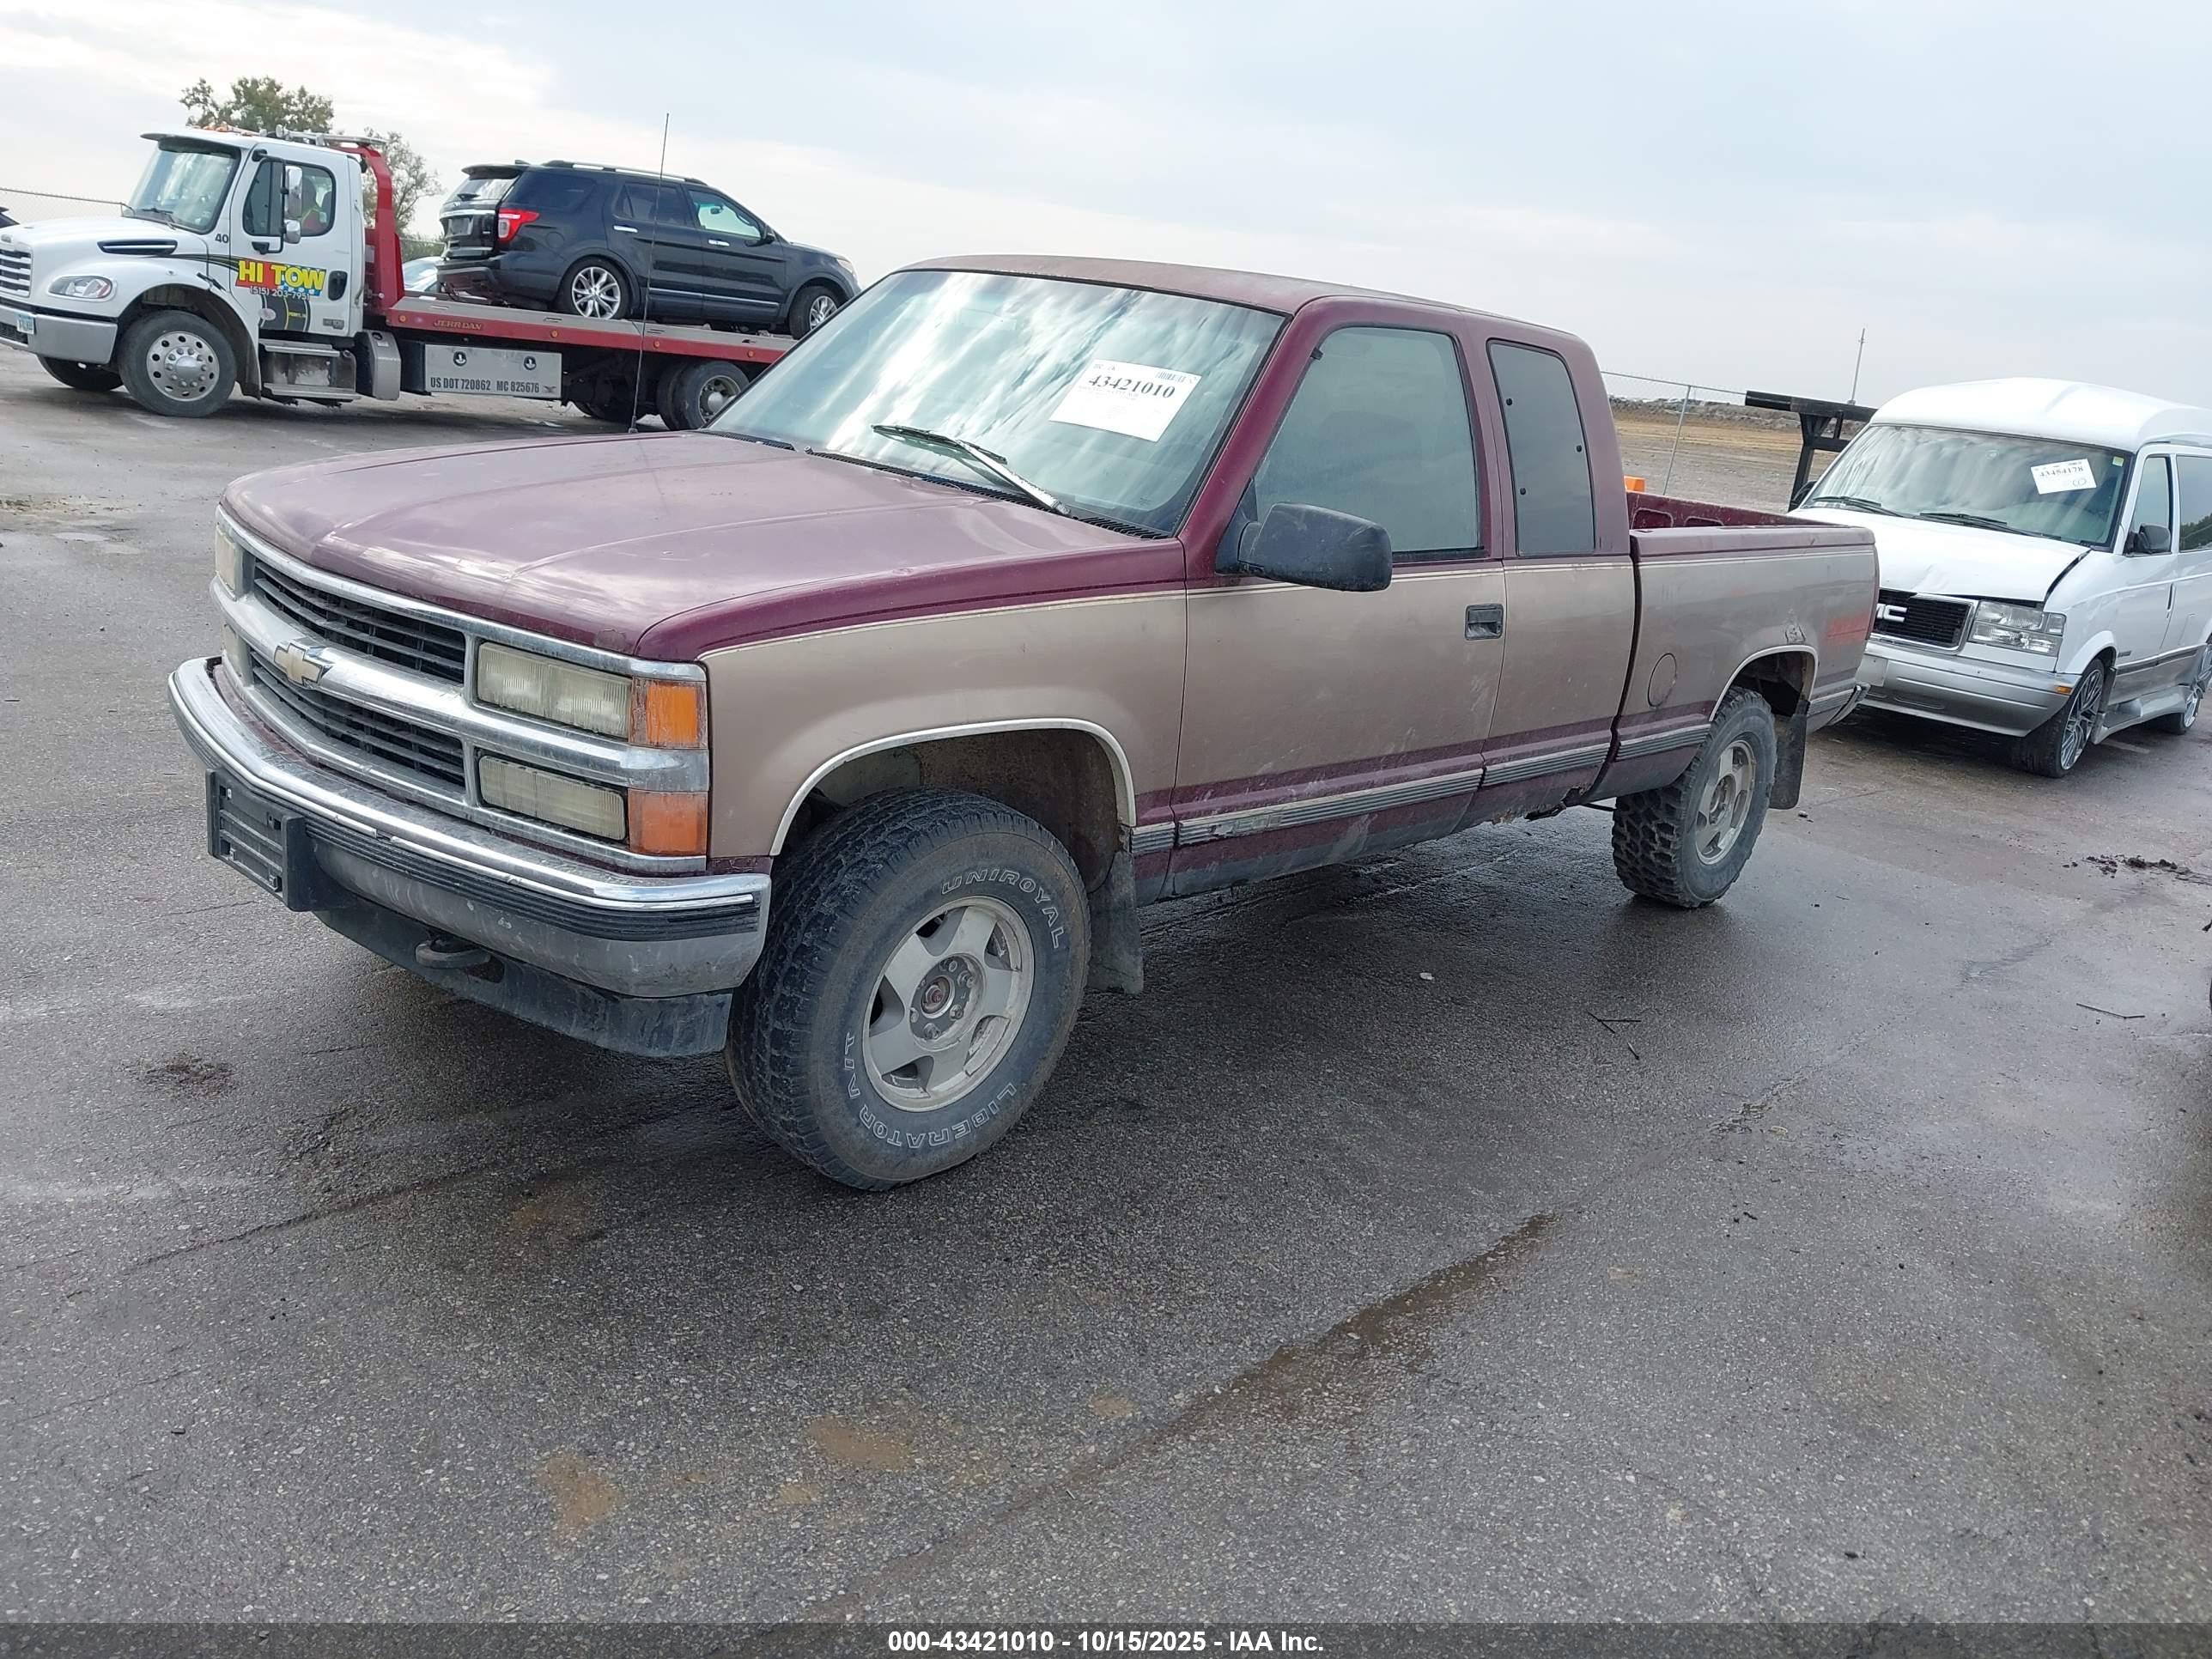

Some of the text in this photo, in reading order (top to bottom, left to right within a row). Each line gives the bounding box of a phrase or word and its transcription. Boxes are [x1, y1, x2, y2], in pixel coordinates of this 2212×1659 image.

[215, 234, 229, 244] 40
[239, 260, 325, 290] HI TOW
[250, 285, 270, 295] (515)
[430, 377, 539, 394] US DOT 720862 MC 825676
[1088, 374, 1176, 398] 43421010
[941, 868, 1065, 949] UNIROYAL
[859, 1082, 1017, 1149] LIBERATOR
